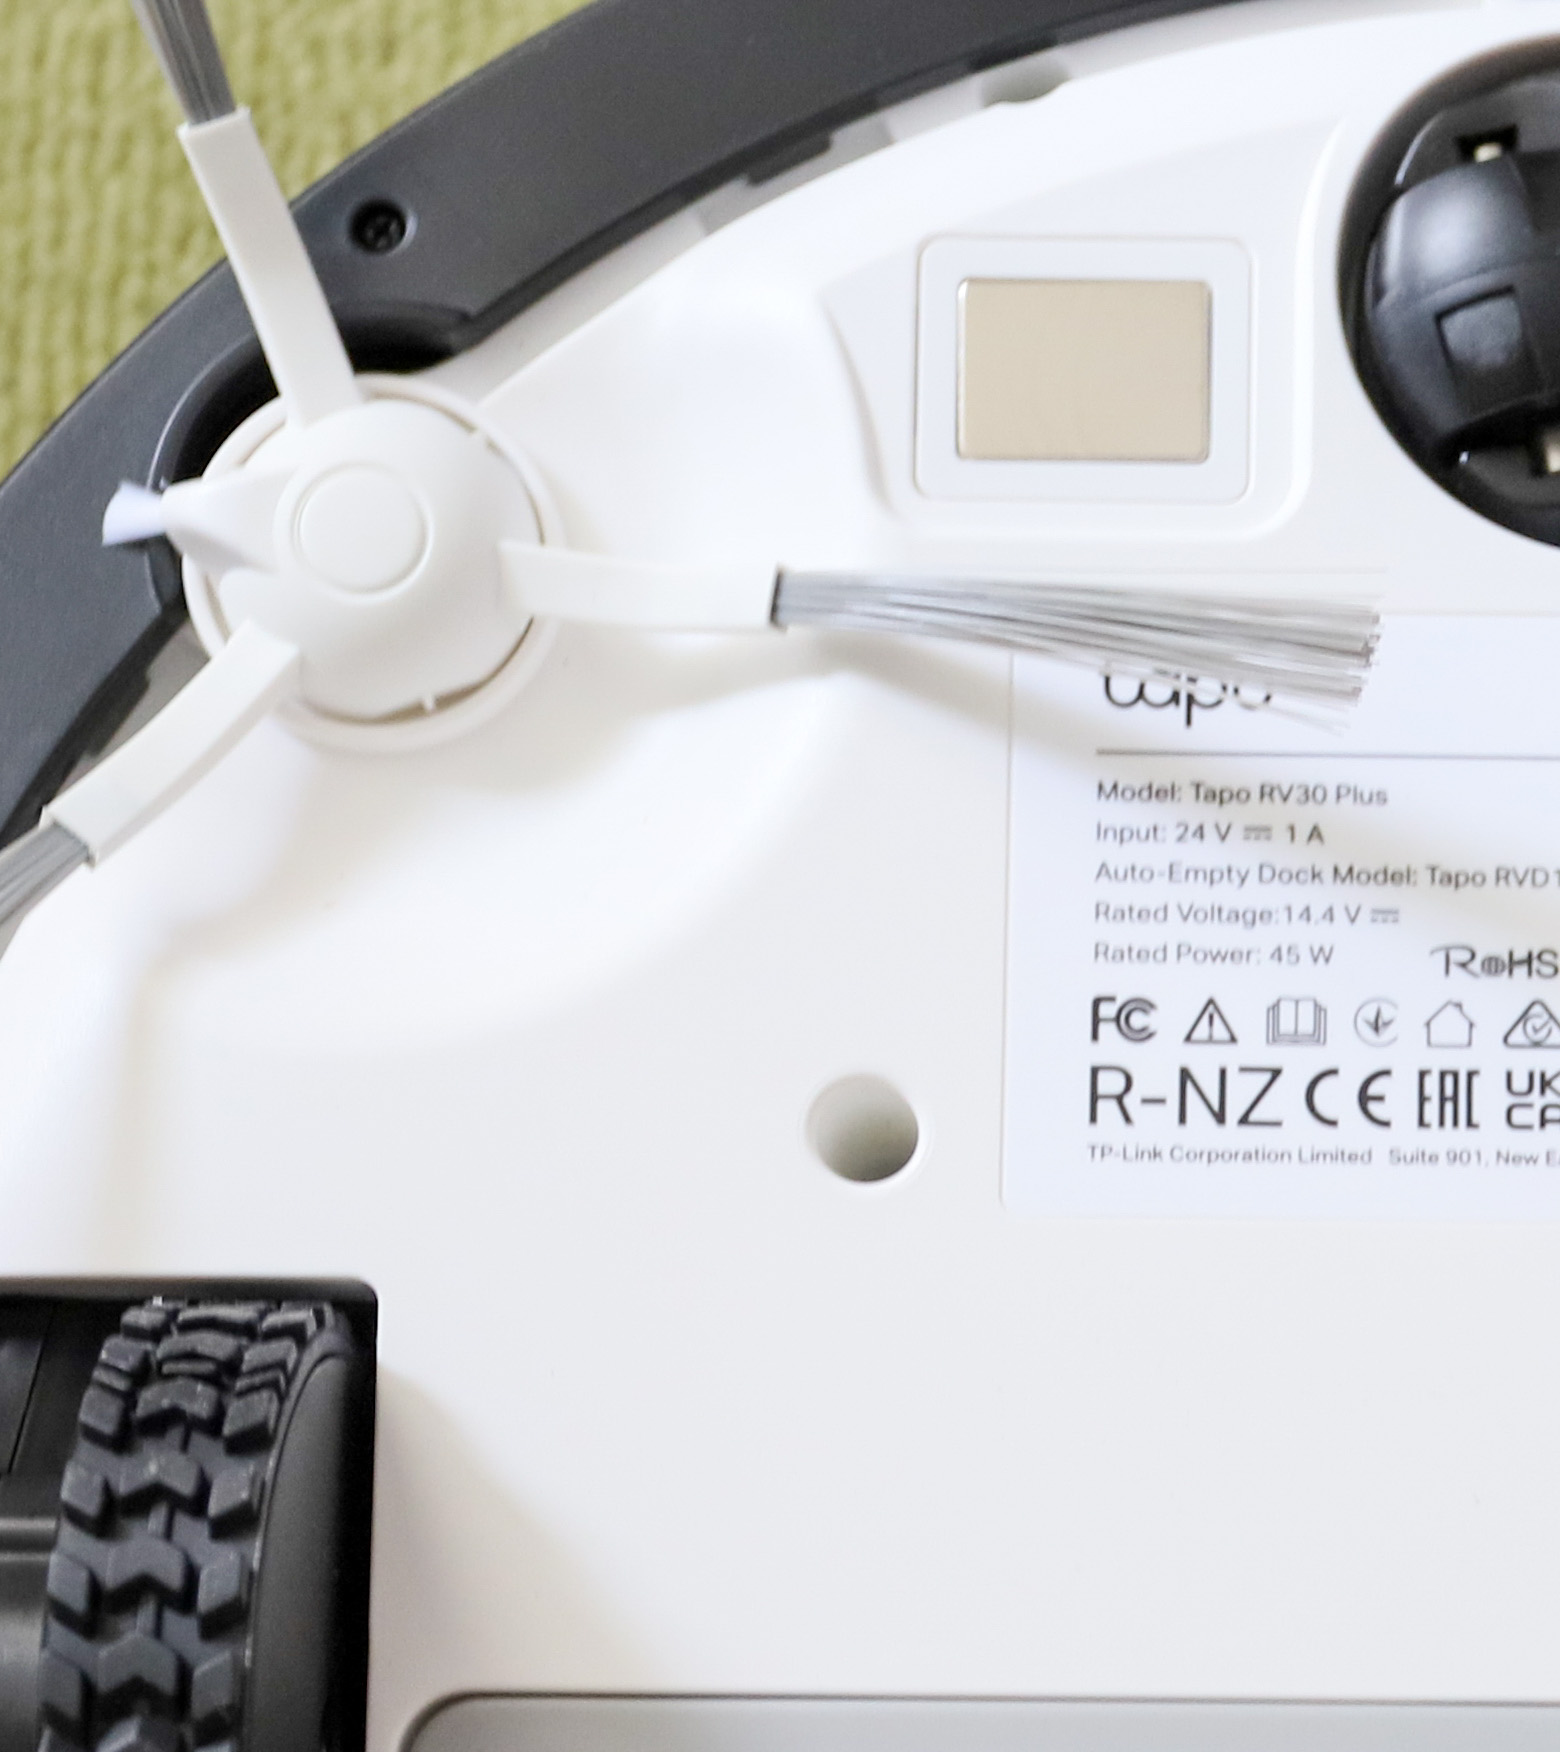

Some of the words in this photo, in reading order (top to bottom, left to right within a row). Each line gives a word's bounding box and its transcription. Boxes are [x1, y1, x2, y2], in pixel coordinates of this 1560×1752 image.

[1096, 779, 1182, 804] Model:
[1188, 781, 1252, 807] Tapo
[1258, 782, 1328, 807] RV30
[1335, 783, 1388, 807] Plus
[1095, 820, 1167, 847] Input:
[1175, 820, 1205, 844] 24
[1213, 820, 1234, 844] V
[1285, 821, 1297, 846] 1
[1304, 821, 1326, 846] A
[1095, 861, 1251, 889] Auto-Empty
[1257, 862, 1324, 886] Dock
[1332, 863, 1418, 888] Model:
[1425, 864, 1487, 891] Tapo
[1094, 902, 1168, 924] Rated
[1343, 904, 1363, 926] V
[1093, 942, 1167, 964] Rated
[1176, 942, 1261, 965] Power:
[1269, 944, 1300, 966] 45
[1308, 944, 1334, 966] W
[1088, 1063, 1284, 1129] R-NZ
[1087, 1144, 1163, 1163] TP-Link
[1169, 1144, 1292, 1168] Corporation
[1298, 1145, 1373, 1165] Limited
[1388, 1147, 1440, 1166] Suite
[1496, 1148, 1539, 1168] New
